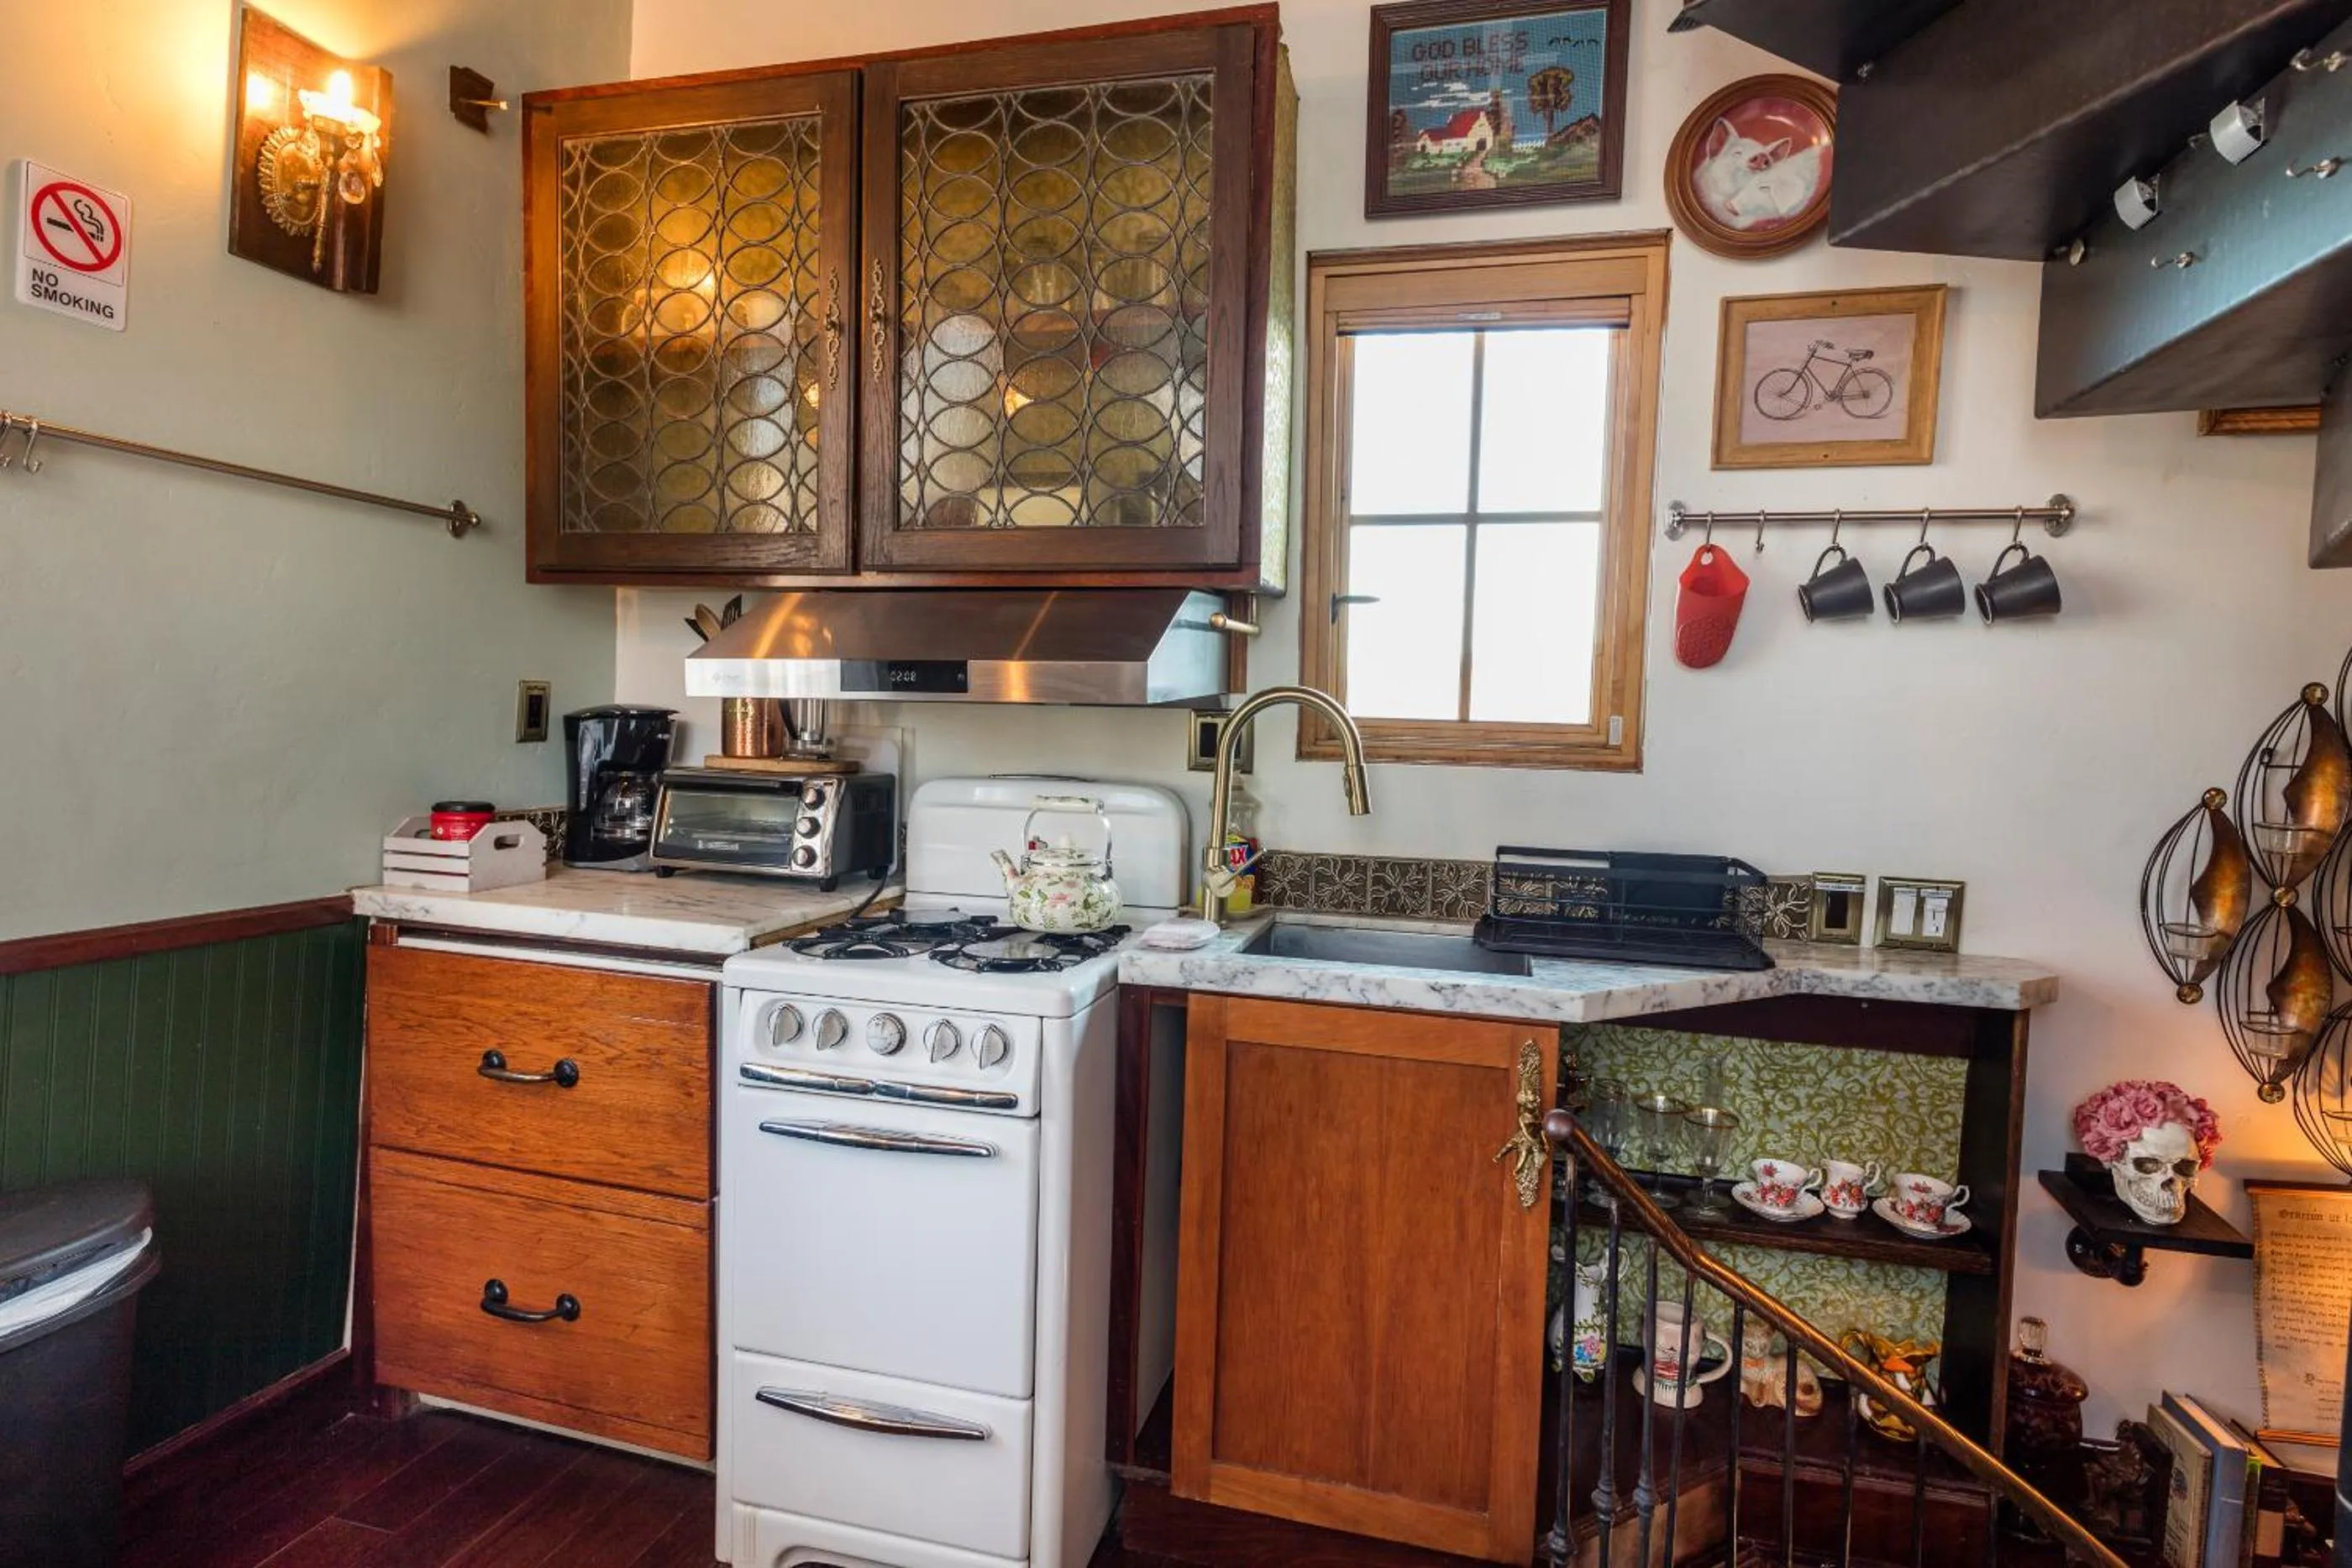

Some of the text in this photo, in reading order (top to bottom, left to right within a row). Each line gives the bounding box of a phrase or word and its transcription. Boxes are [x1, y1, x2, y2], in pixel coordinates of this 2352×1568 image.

[1413, 32, 1529, 61] GOD BLESS
[32, 268, 59, 287] NO
[31, 284, 113, 318] SMOKING
